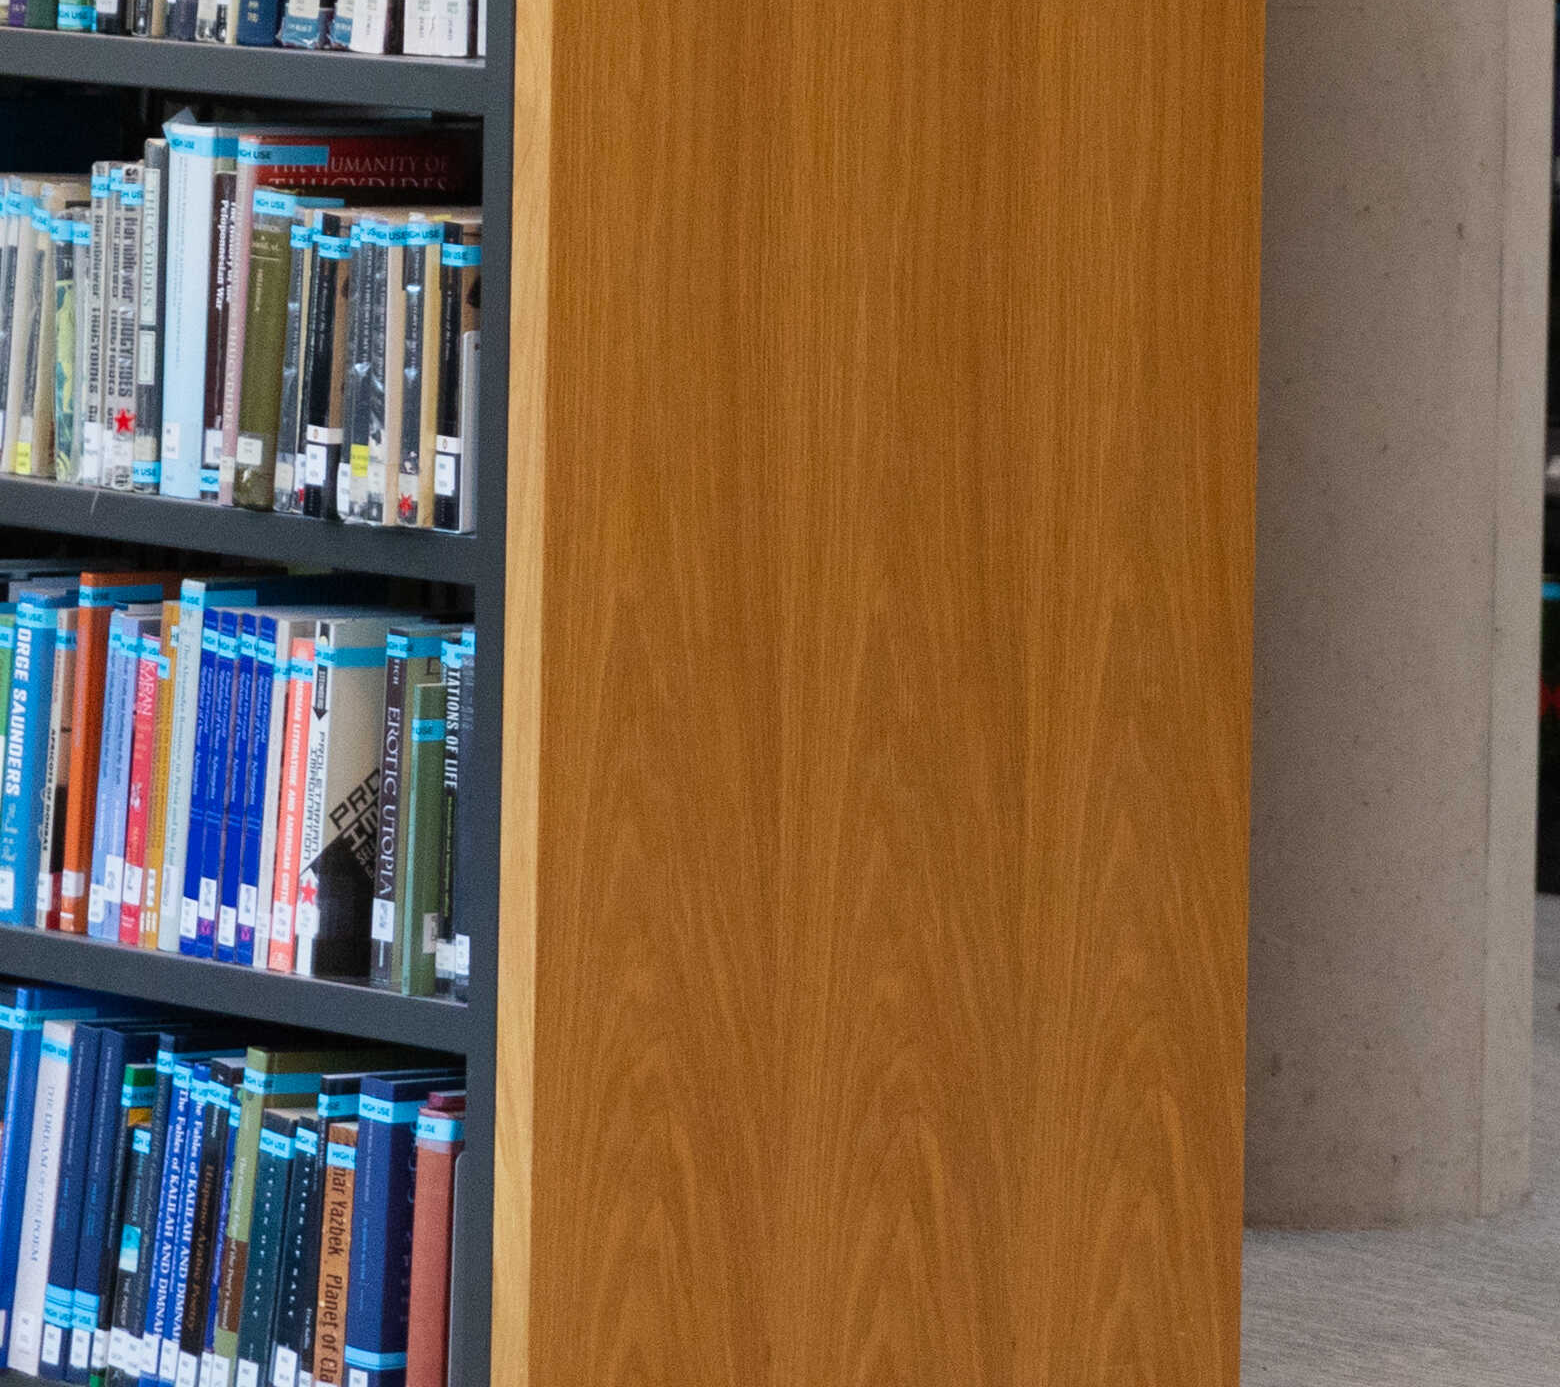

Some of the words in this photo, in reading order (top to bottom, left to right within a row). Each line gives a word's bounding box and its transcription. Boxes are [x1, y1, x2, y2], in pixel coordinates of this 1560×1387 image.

[15, 627, 32, 683] ORGE
[6, 690, 28, 797] SAUNDERS
[384, 706, 401, 796] EROTIC
[444, 742, 459, 763] OF
[443, 764, 459, 790] LIFE
[379, 805, 397, 897] UTOPIA
[176, 1089, 188, 1112] The
[173, 1116, 186, 1154] Fables
[191, 1120, 204, 1157] Fables
[164, 1174, 180, 1238] KALILAH
[182, 1178, 198, 1242] KALILAH
[327, 1199, 348, 1257] Yazbek
[159, 1240, 172, 1275] AND
[177, 1245, 191, 1279] AND
[319, 1273, 344, 1332] Planet
[320, 1334, 337, 1353] of
